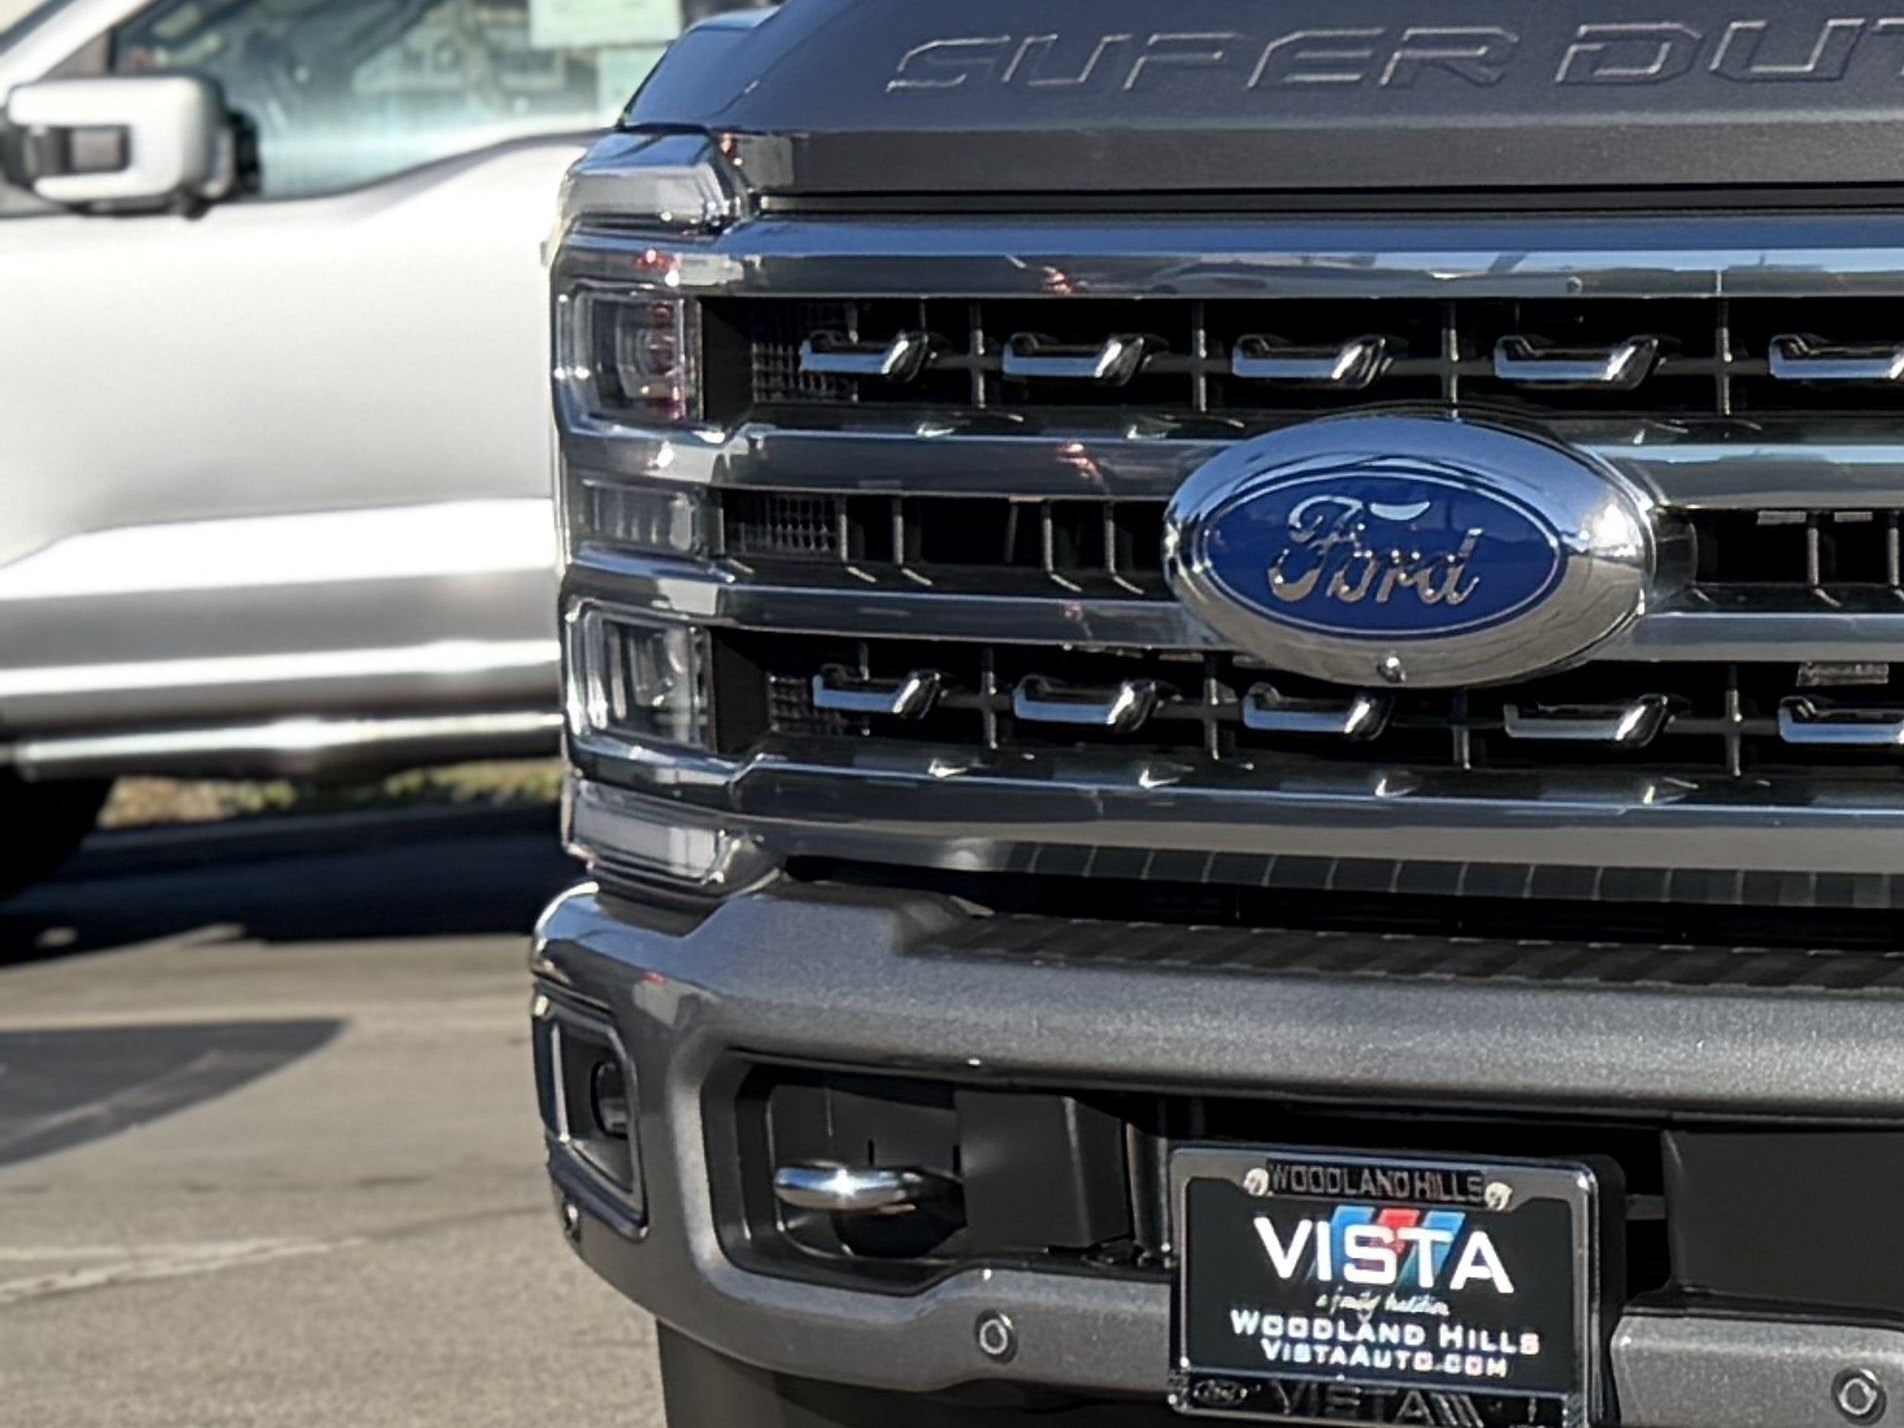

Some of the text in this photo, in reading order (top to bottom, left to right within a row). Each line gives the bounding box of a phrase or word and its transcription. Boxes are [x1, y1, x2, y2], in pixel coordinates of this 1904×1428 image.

[885, 27, 1521, 92] SUPER
[1268, 494, 1485, 606] Ford
[1269, 1163, 1483, 1203] WOODLAND HILLS
[1253, 1216, 1515, 1294] VISTA
[1230, 1309, 1540, 1356] WOODLAND HILLS
